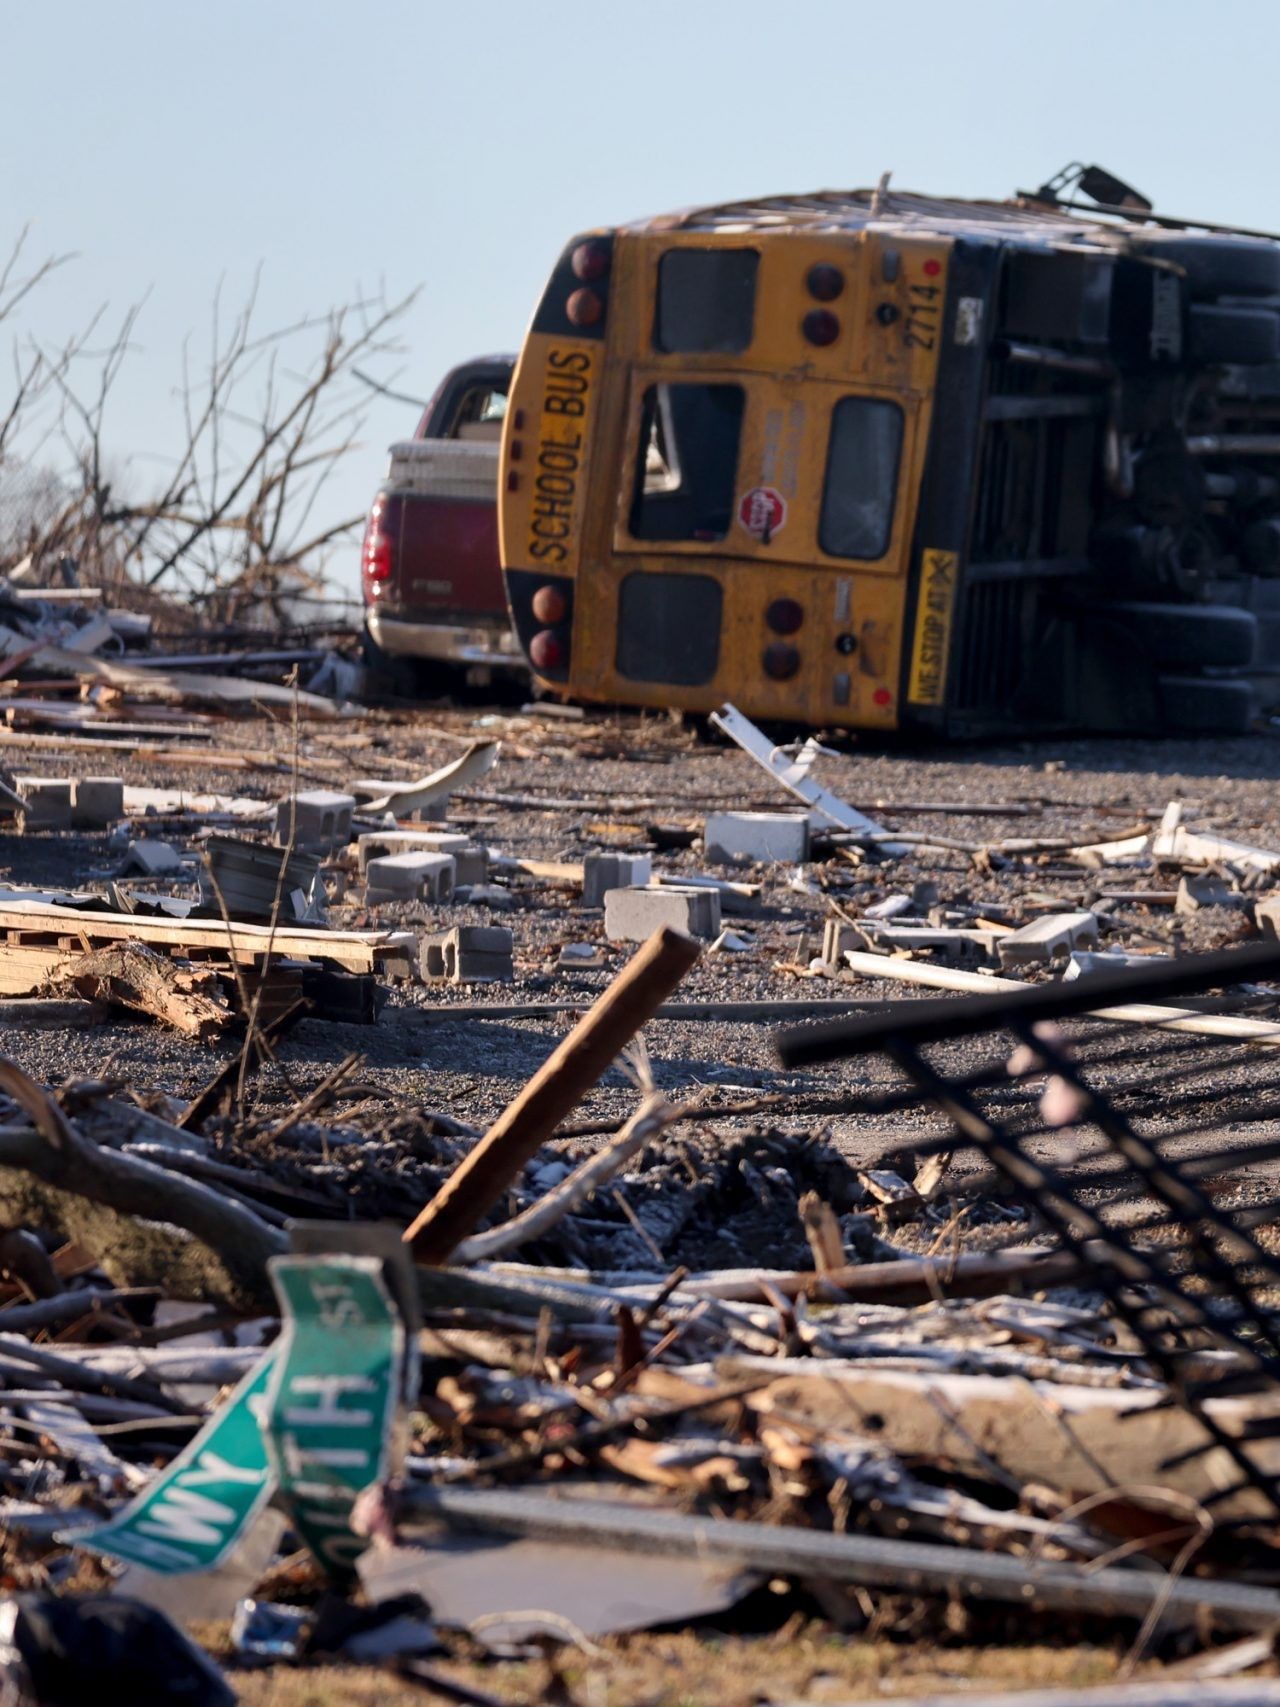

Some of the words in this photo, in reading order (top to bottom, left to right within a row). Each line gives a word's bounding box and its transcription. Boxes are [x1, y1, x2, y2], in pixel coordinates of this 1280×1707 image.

[903, 284, 939, 349] 2714
[544, 351, 592, 418] BUS
[529, 434, 582, 561] SCHOOL
[926, 587, 947, 614] AT
[920, 615, 946, 664] STOP
[917, 668, 940, 699] WE
[311, 1281, 364, 1329] ST
[283, 1375, 379, 1567] OUTH
[102, 1450, 266, 1565] HWY
